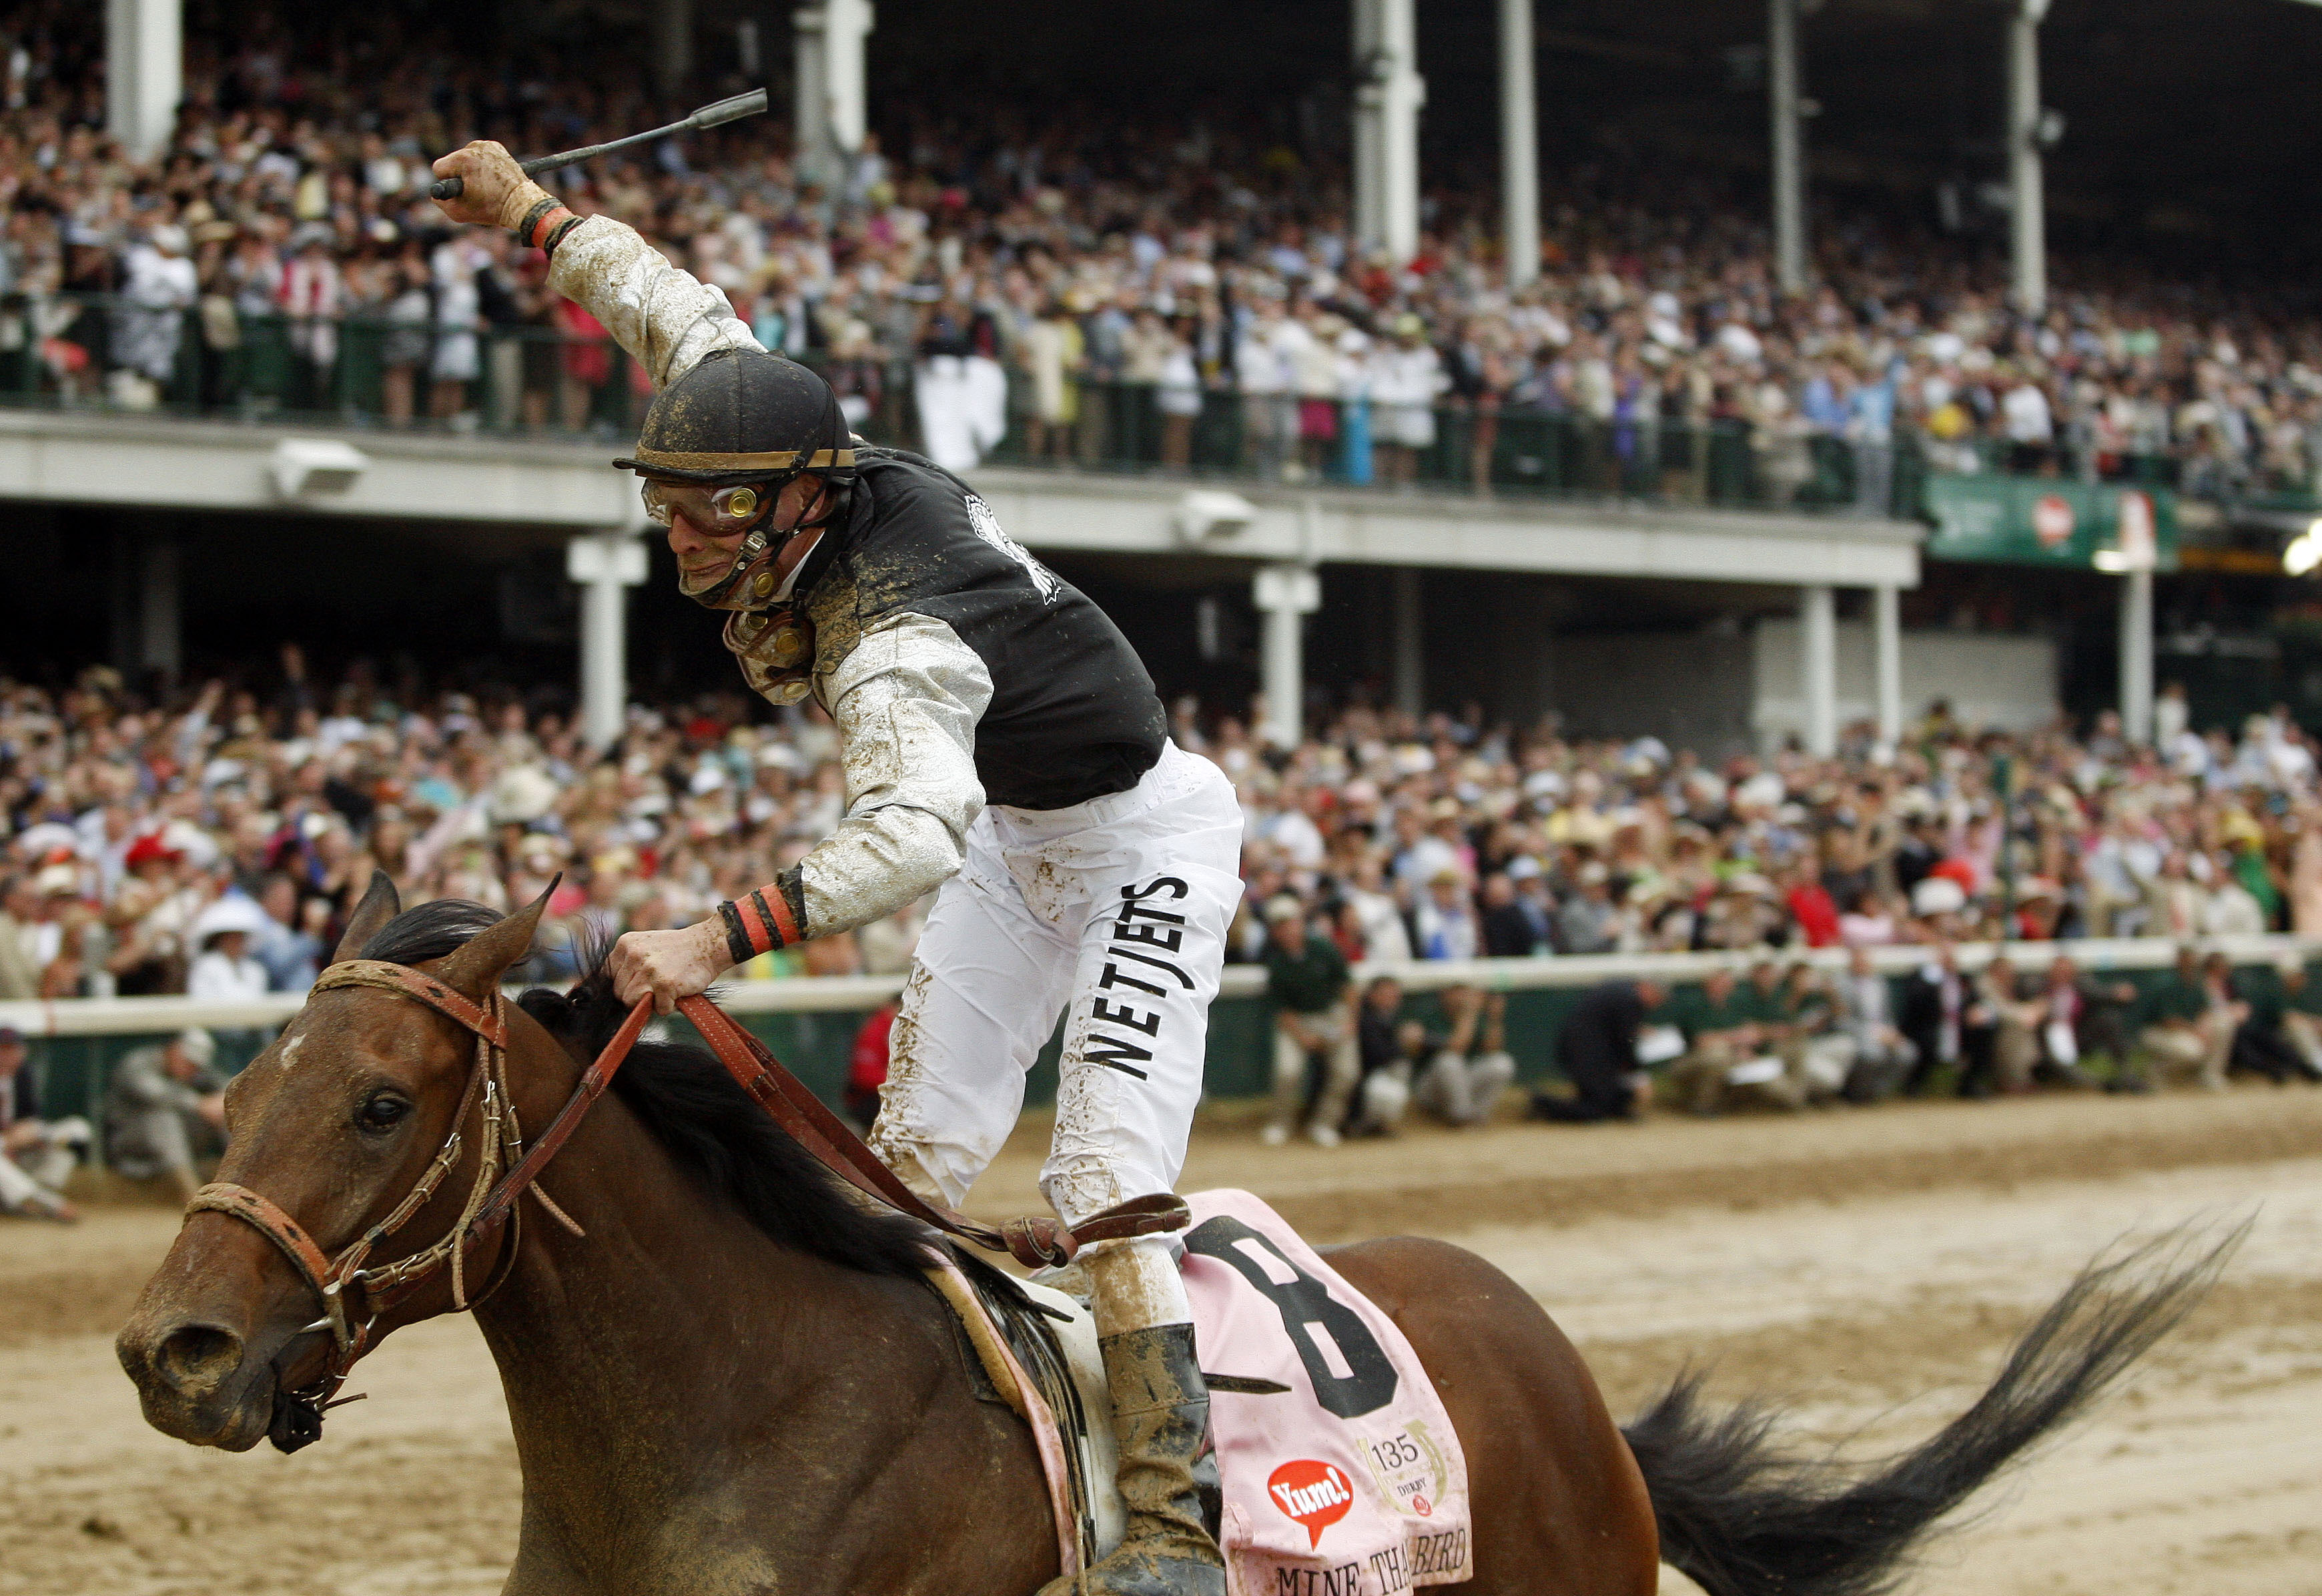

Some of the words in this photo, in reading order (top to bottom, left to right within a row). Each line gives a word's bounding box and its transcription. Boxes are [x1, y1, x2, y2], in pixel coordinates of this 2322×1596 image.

[1084, 877, 1196, 1081] NETJETS
[1184, 1215, 1399, 1419] 8
[1372, 1433, 1419, 1471] 135
[1272, 1467, 1350, 1517] Yum!
[1397, 1477, 1427, 1496] DERBY
[1277, 1562, 1362, 1596] MINE
[1370, 1542, 1411, 1595] THA
[1413, 1529, 1466, 1576] BIRD
